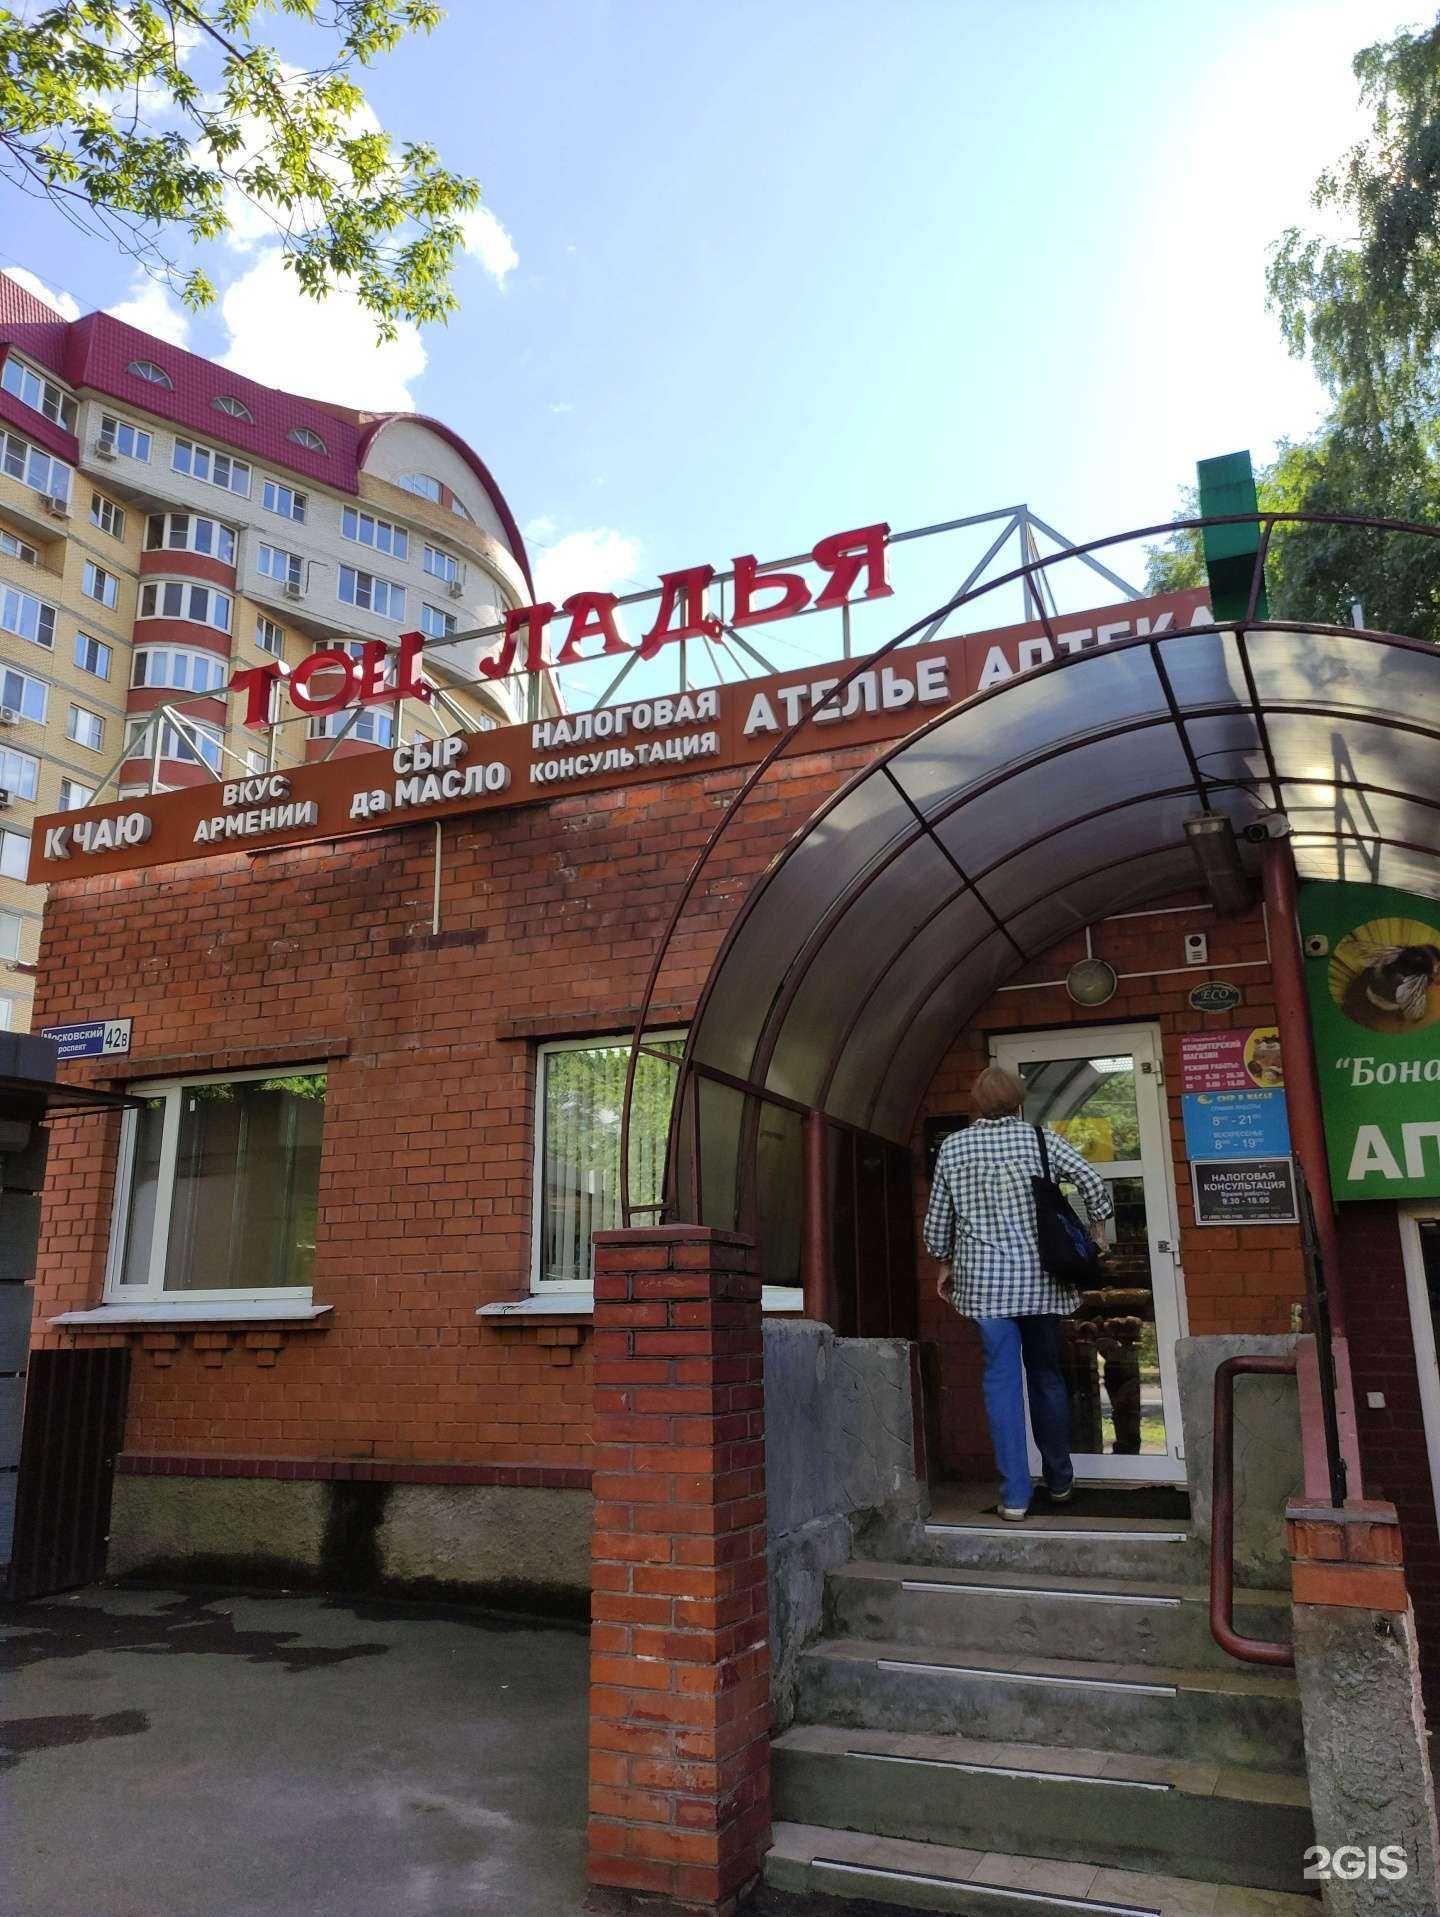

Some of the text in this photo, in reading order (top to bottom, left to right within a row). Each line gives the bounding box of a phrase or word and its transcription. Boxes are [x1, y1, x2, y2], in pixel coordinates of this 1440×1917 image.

[228, 522, 893, 728] ТОЦ ЛАДЬЯ
[532, 690, 719, 749] НАЛОГОВАЯ
[743, 656, 948, 736] АТЕЛЬЕ
[393, 738, 466, 775] СЫР
[529, 731, 718, 783] КОНСУЛЬТАЦИЯ
[223, 774, 289, 807] ВКУС
[349, 762, 509, 820] да МАСЛО
[43, 812, 149, 861] К ЧАЮ
[193, 801, 316, 843] АРМЕНИИ
[1203, 1181, 1286, 1192] КОНСУЛЬТАЦИЯ
[1211, 1172, 1276, 1182] НАЛОГОВАЯ
